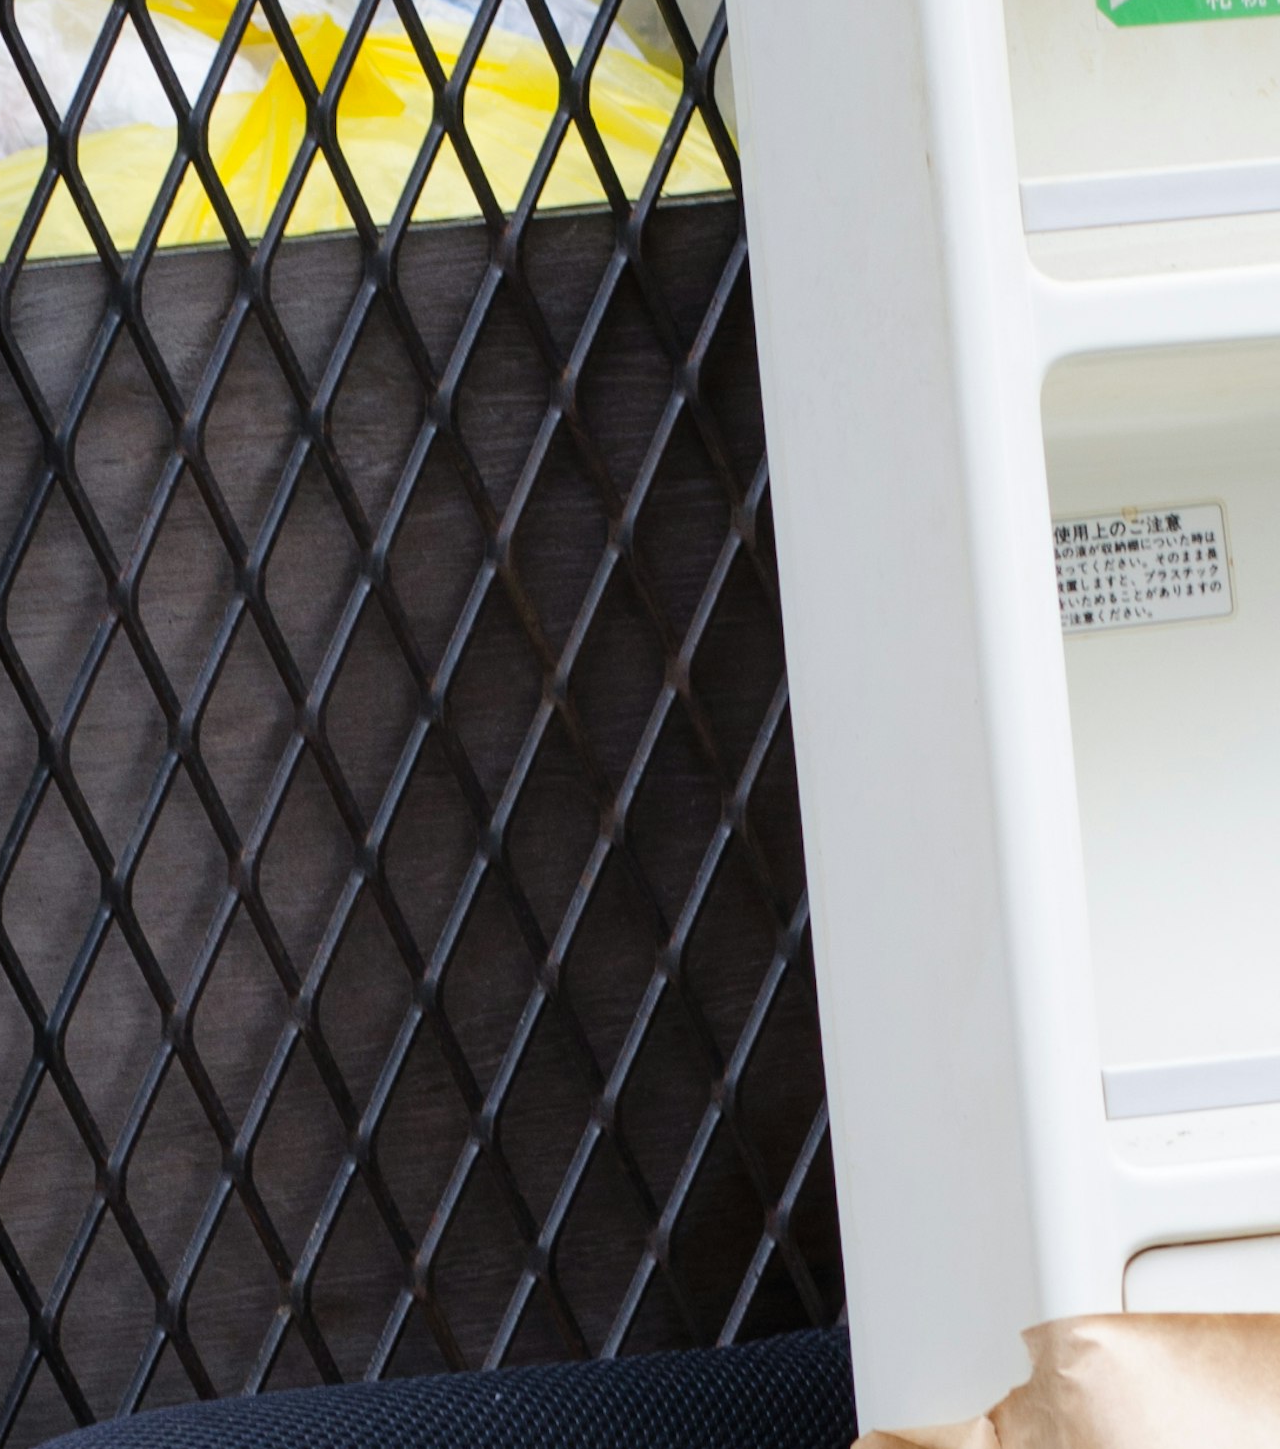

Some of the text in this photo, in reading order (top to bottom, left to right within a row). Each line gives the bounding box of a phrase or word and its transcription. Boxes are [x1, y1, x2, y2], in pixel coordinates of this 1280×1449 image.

[1054, 513, 1182, 546] 使用上のご注意
